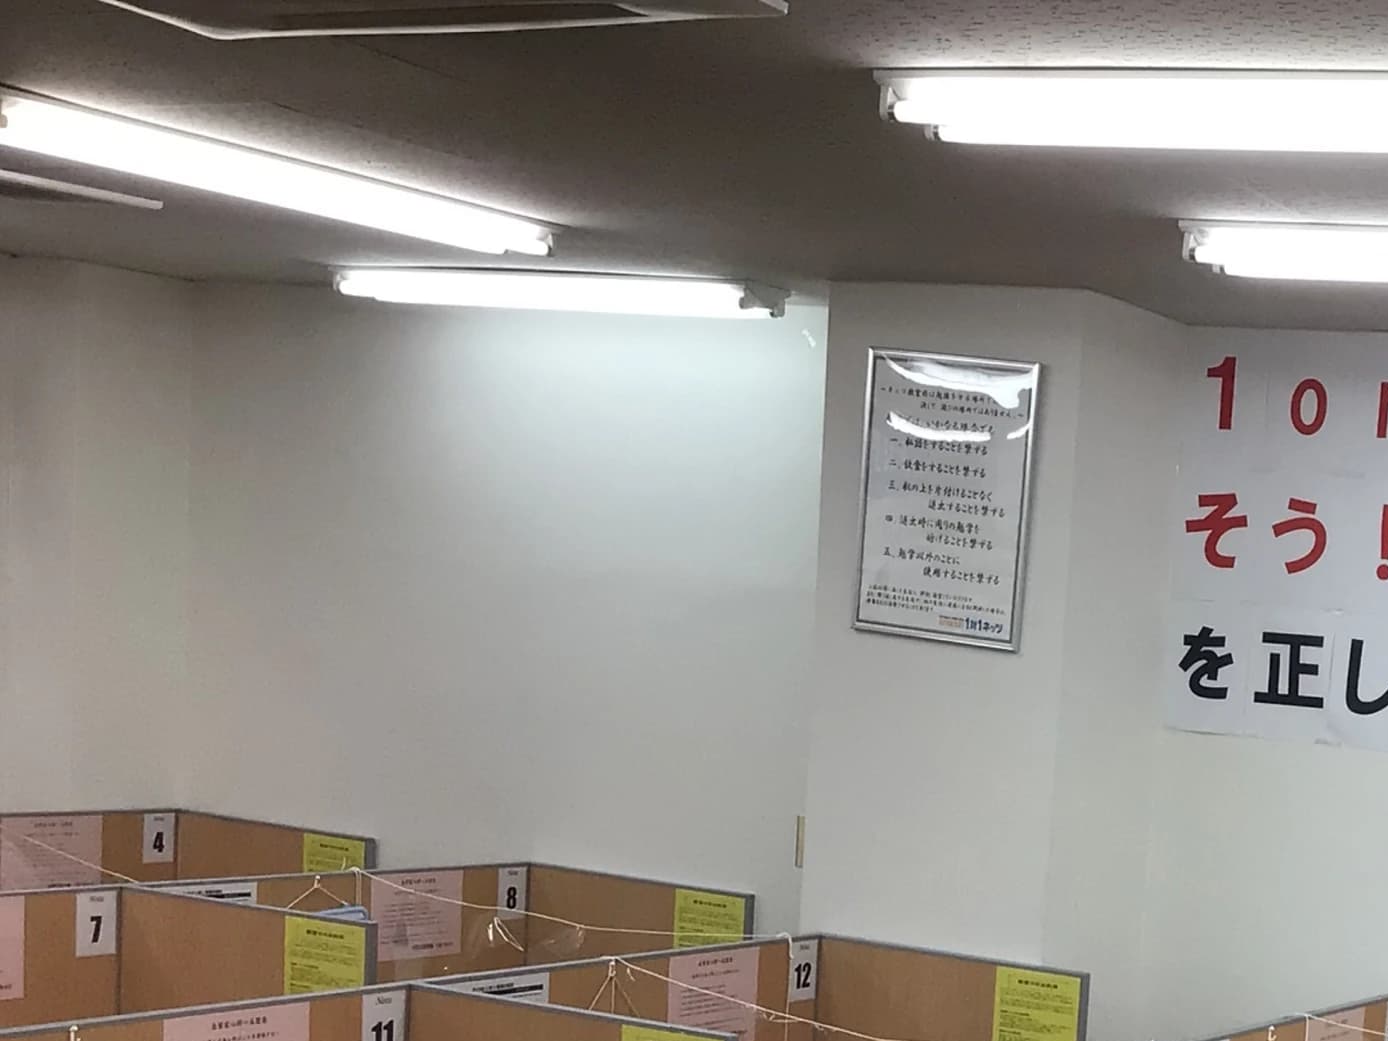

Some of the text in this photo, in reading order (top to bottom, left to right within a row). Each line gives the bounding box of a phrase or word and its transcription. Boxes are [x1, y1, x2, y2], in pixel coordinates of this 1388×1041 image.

[153, 831, 165, 853] 4
[506, 886, 517, 909] 8
[90, 915, 103, 943] 7
[793, 962, 812, 990] 12
